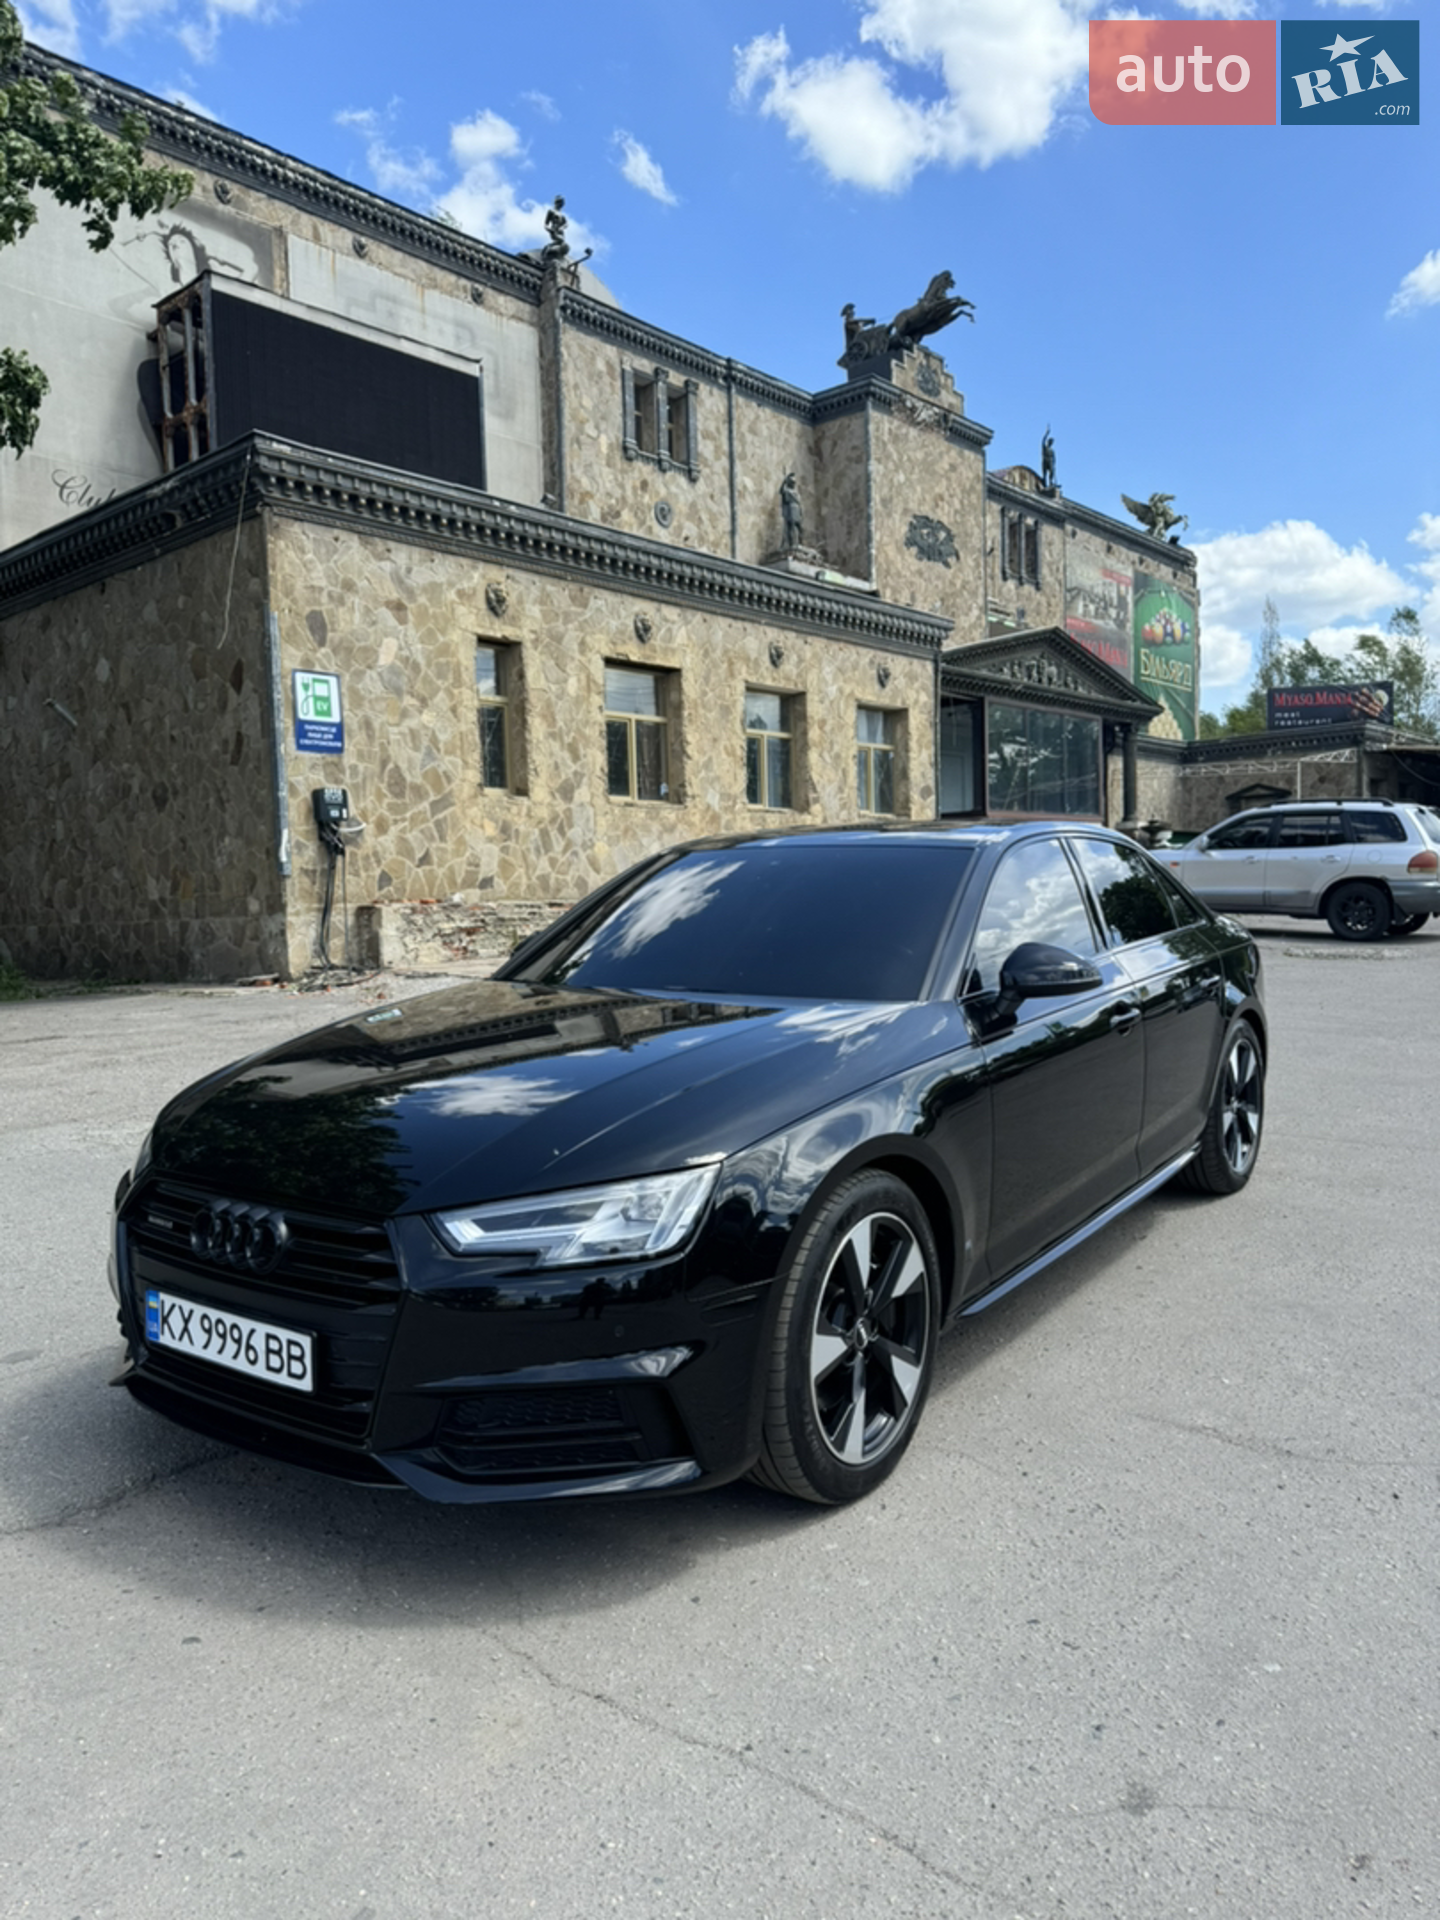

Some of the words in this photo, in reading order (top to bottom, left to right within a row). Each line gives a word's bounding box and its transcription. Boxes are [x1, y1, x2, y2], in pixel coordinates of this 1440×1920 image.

[1140, 647, 1192, 688] БІЛЬЯРД
[316, 700, 329, 711] EV
[1273, 692, 1313, 707] MYASO
[1315, 690, 1352, 705] MANIA
[200, 1312, 259, 1366] 9996
[264, 1331, 308, 1381] BB
